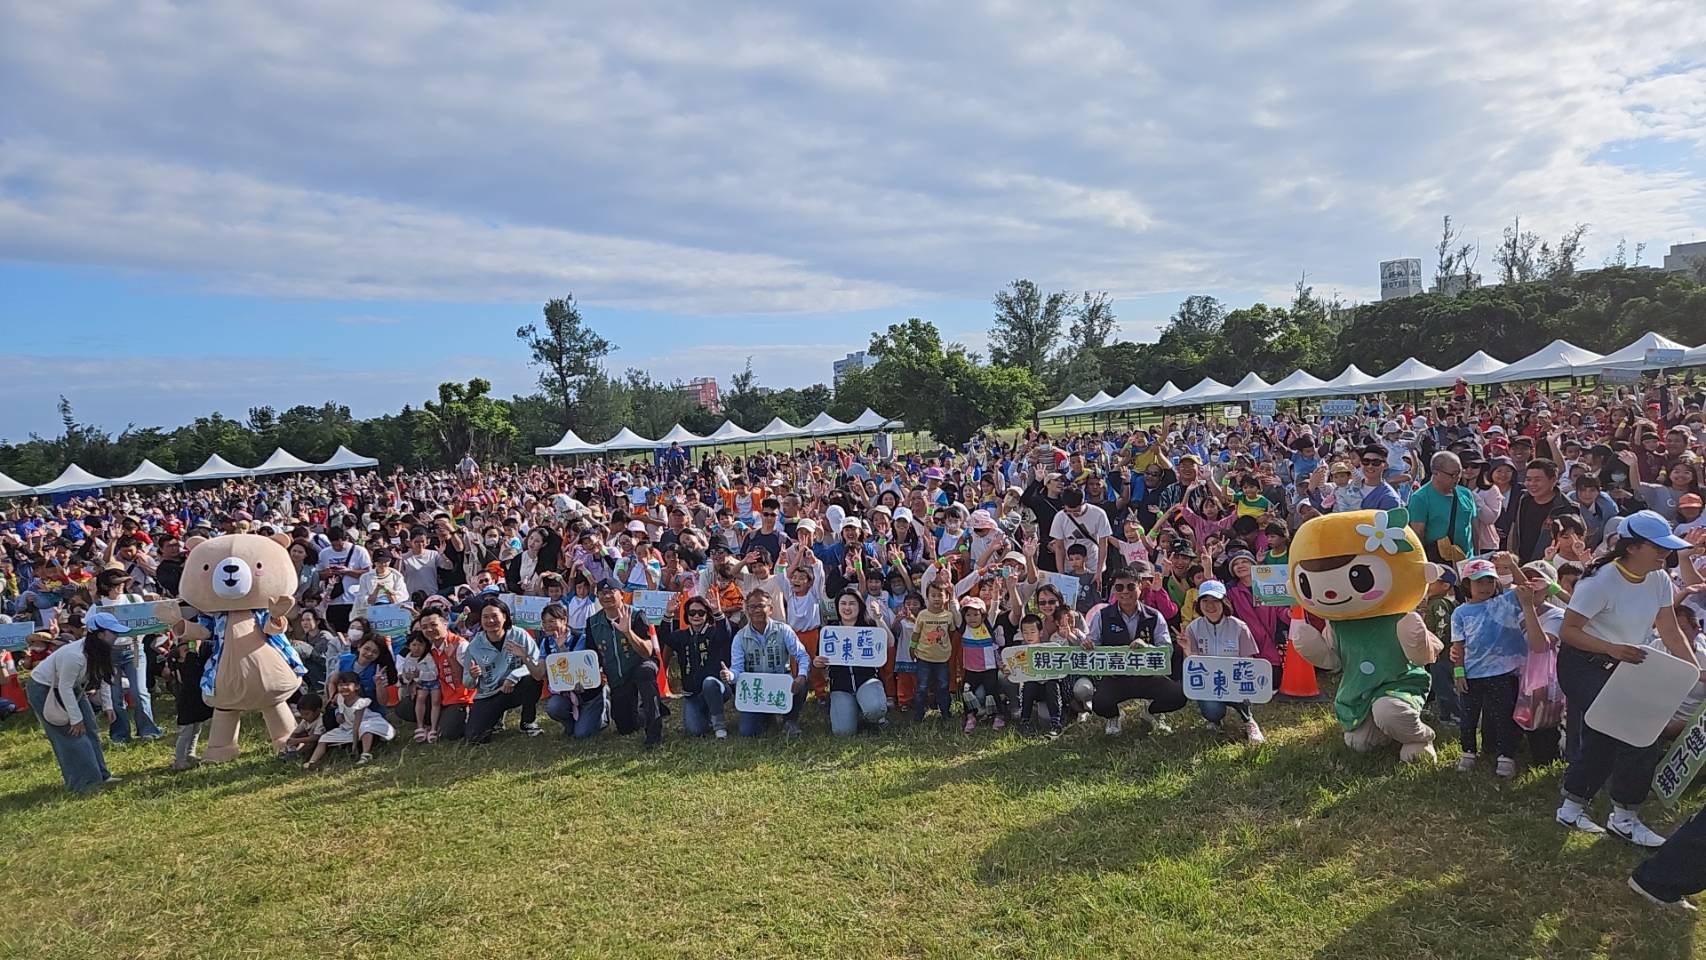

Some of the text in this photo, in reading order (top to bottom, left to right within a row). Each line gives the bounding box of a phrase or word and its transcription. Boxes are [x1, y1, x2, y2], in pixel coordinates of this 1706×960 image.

[823, 629, 874, 660] 台東藍
[550, 655, 593, 688] 陽光
[1034, 651, 1165, 671] 親子健行嘉年華
[740, 678, 788, 708] 綠地
[1187, 660, 1256, 697] 台東藍
[1656, 708, 1706, 797] 親子健
